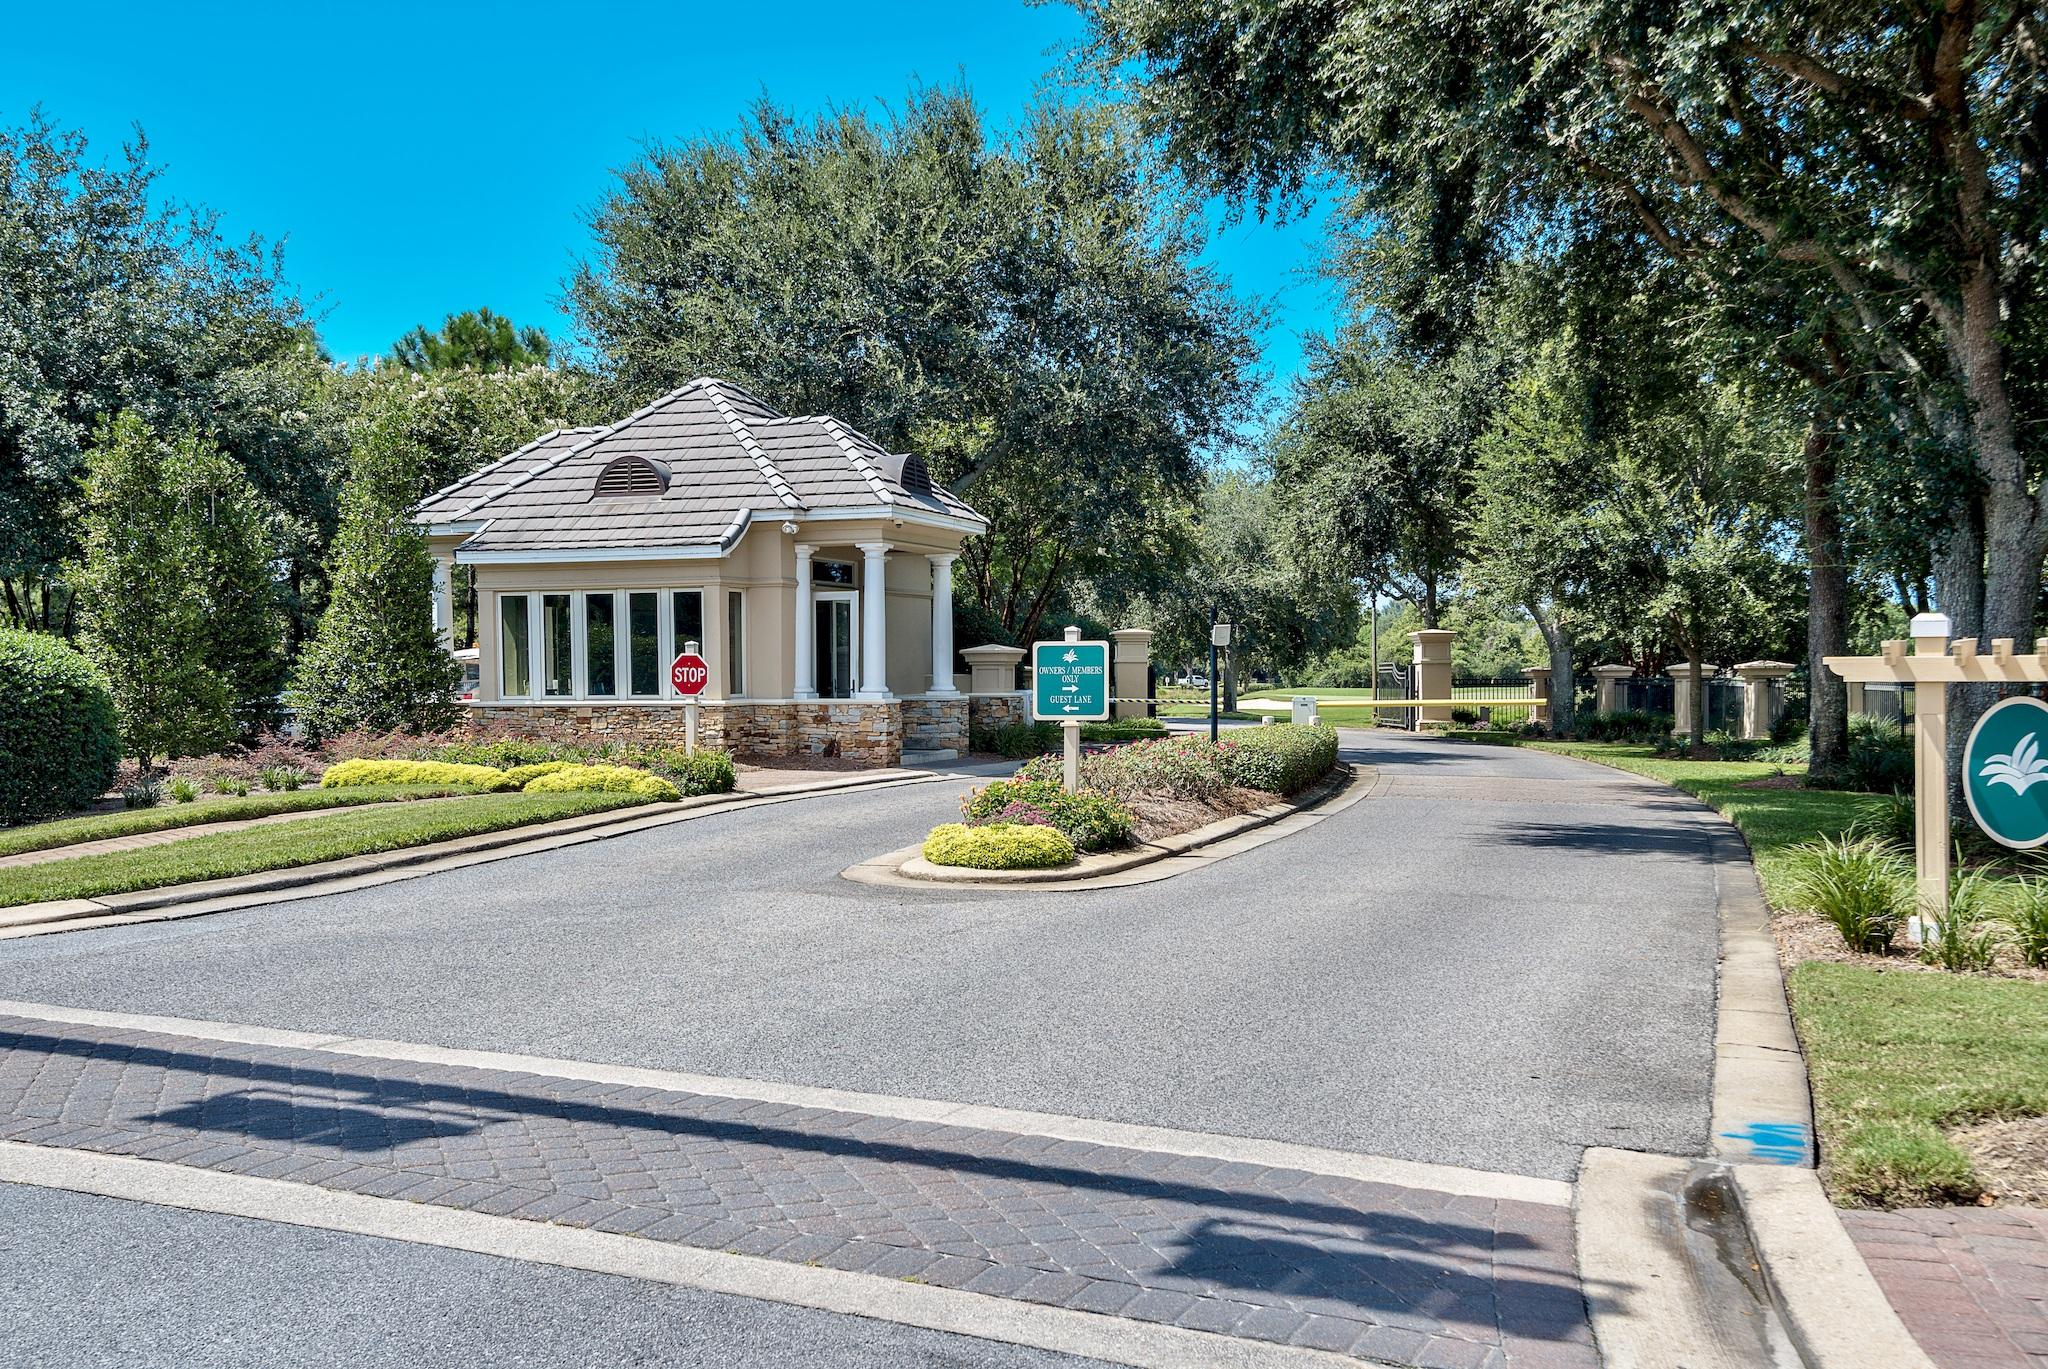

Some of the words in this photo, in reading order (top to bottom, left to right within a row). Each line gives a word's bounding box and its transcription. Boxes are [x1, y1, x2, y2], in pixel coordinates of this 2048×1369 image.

[674, 667, 706, 683] STOP
[1039, 666, 1066, 675] OWNERS
[1071, 666, 1103, 675] MEMBERS
[1061, 675, 1079, 683] ONLY
[1050, 695, 1072, 704] GUEST
[1074, 695, 1092, 704] LANE
